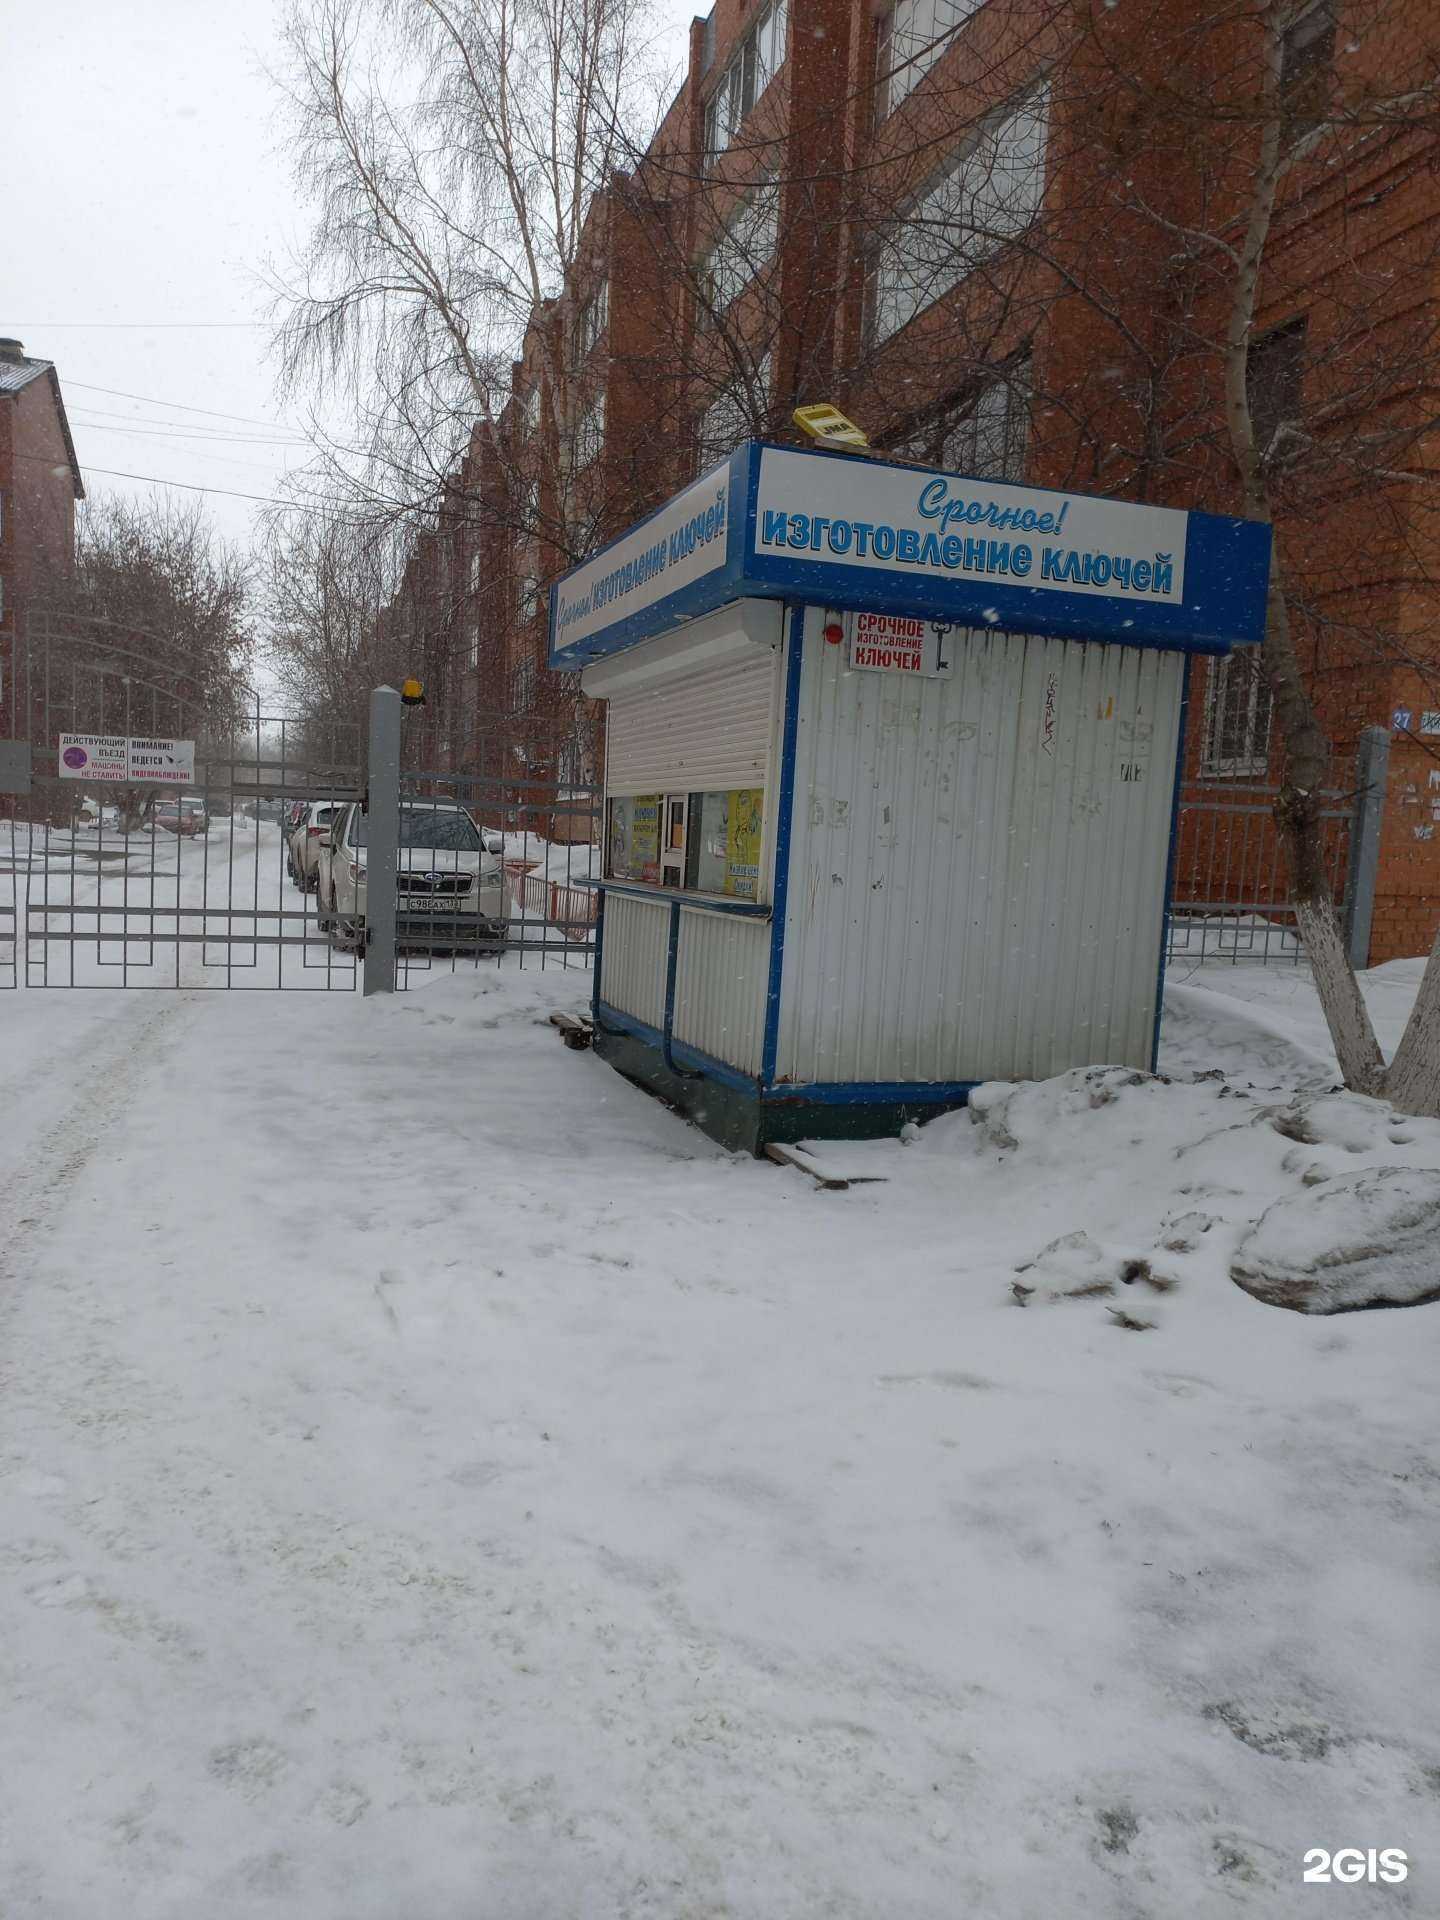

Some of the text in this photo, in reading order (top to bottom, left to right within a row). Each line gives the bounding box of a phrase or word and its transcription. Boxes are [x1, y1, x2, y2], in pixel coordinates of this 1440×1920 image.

[917, 478, 1070, 535] Срочное!
[857, 613, 925, 638] СРОЧНОЕ
[857, 632, 923, 650] ИЗГОТОВЛЕНИЕ
[855, 647, 922, 671] КЛЮЧЕЙ
[1392, 713, 1411, 729] 27
[62, 735, 126, 747] ДЕЙСТВУЮЩИЙ
[131, 740, 174, 751] ВНИМАНИЕ!
[98, 749, 125, 759] ВЪЕЗД
[131, 755, 163, 766] ВЕДЕТСЯ
